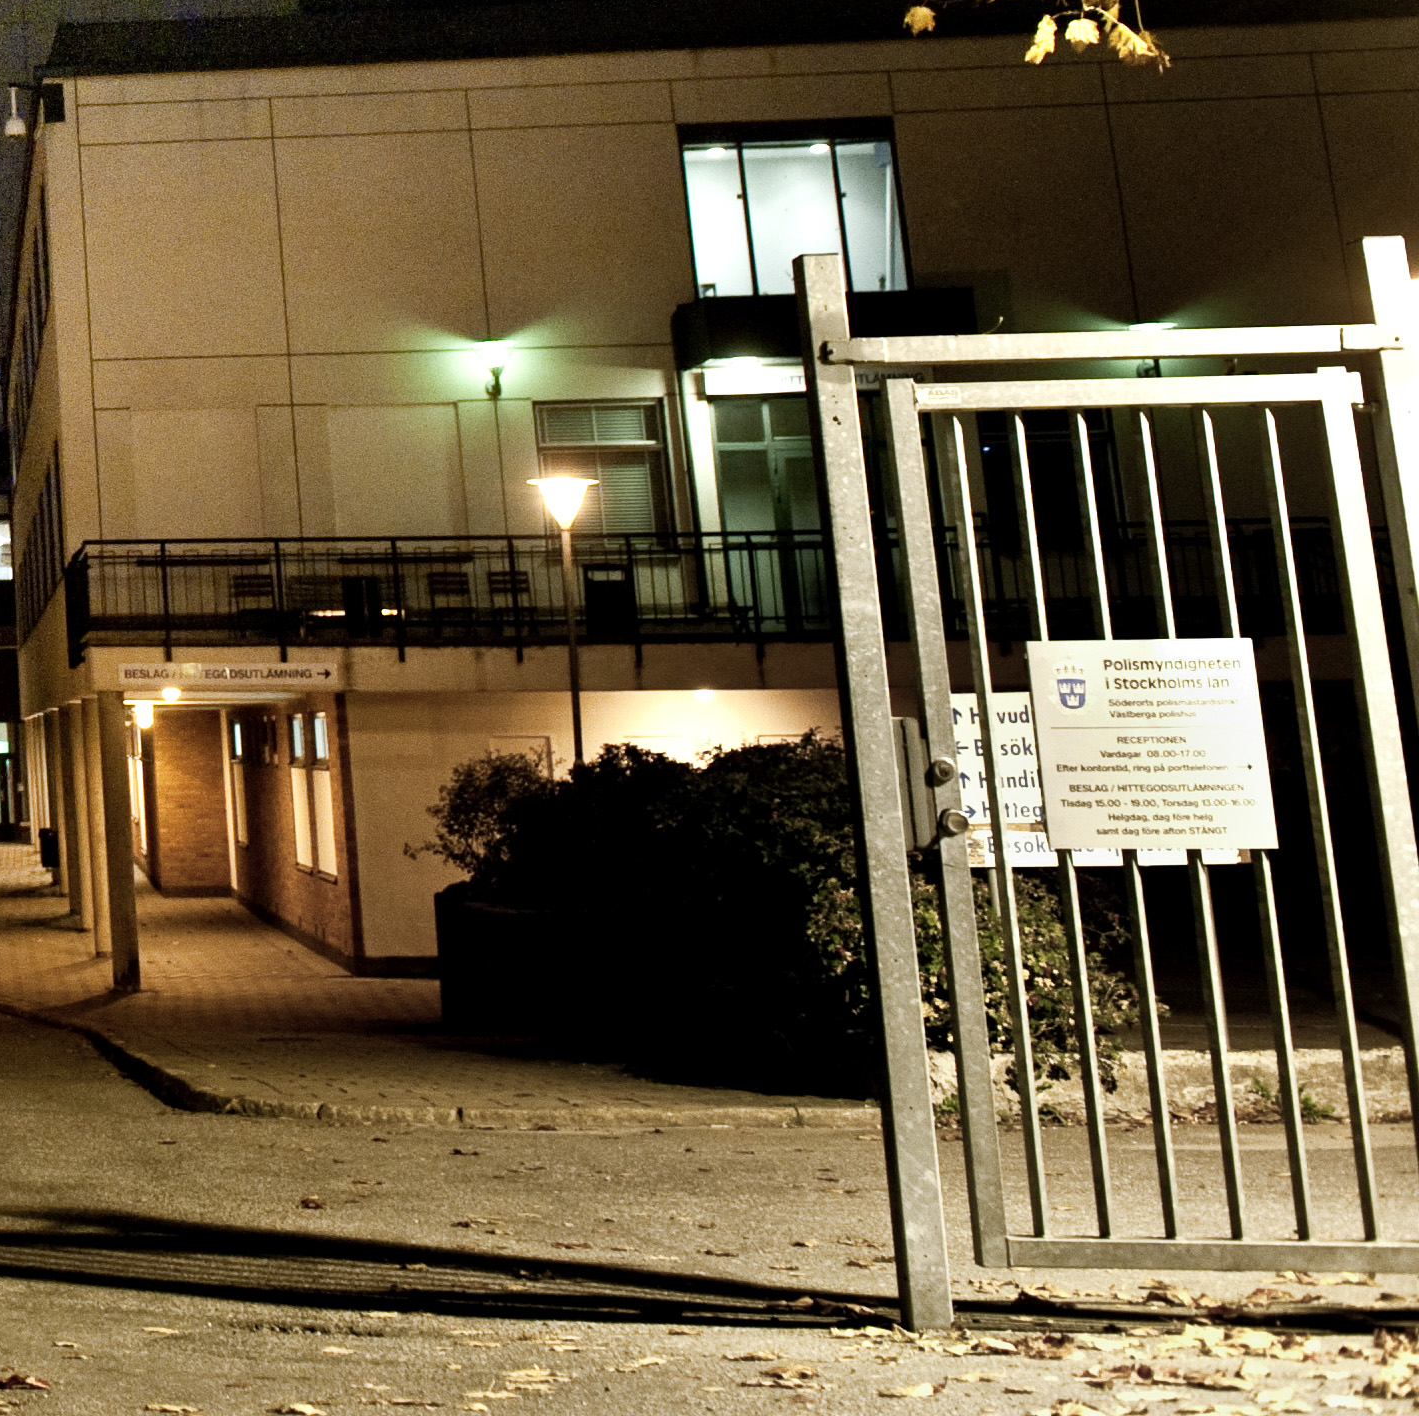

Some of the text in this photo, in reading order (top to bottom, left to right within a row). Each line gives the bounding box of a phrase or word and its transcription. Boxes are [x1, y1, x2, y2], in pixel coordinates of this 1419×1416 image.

[1103, 658, 1241, 673] Polismyndigheten
[124, 669, 170, 680] BESLAG
[1105, 676, 1110, 690] i
[1114, 676, 1203, 690] Stockholms
[1109, 709, 1157, 720] Västberga
[1116, 736, 1187, 745] RECEPTIONEN
[1099, 749, 1142, 760] Vardagar
[1056, 763, 1078, 772] Efter
[1132, 764, 1151, 774] ring
[1153, 762, 1166, 773] på
[1167, 763, 1229, 773] porttelefonen
[1069, 784, 1109, 793] BESLAG
[1117, 782, 1244, 793] HITTEGODSUTLÄMNINGEN
[1060, 798, 1093, 809] Tisdag
[1094, 798, 1122, 807] 15.00
[1161, 798, 1199, 808] Torsdag
[1152, 813, 1171, 823] dag
[1172, 812, 1191, 821] före
[1192, 812, 1214, 823] helg
[1096, 827, 1120, 835] samt
[1121, 826, 1140, 836] dag
[1141, 826, 1161, 835] före
[1162, 826, 1187, 835] afton
